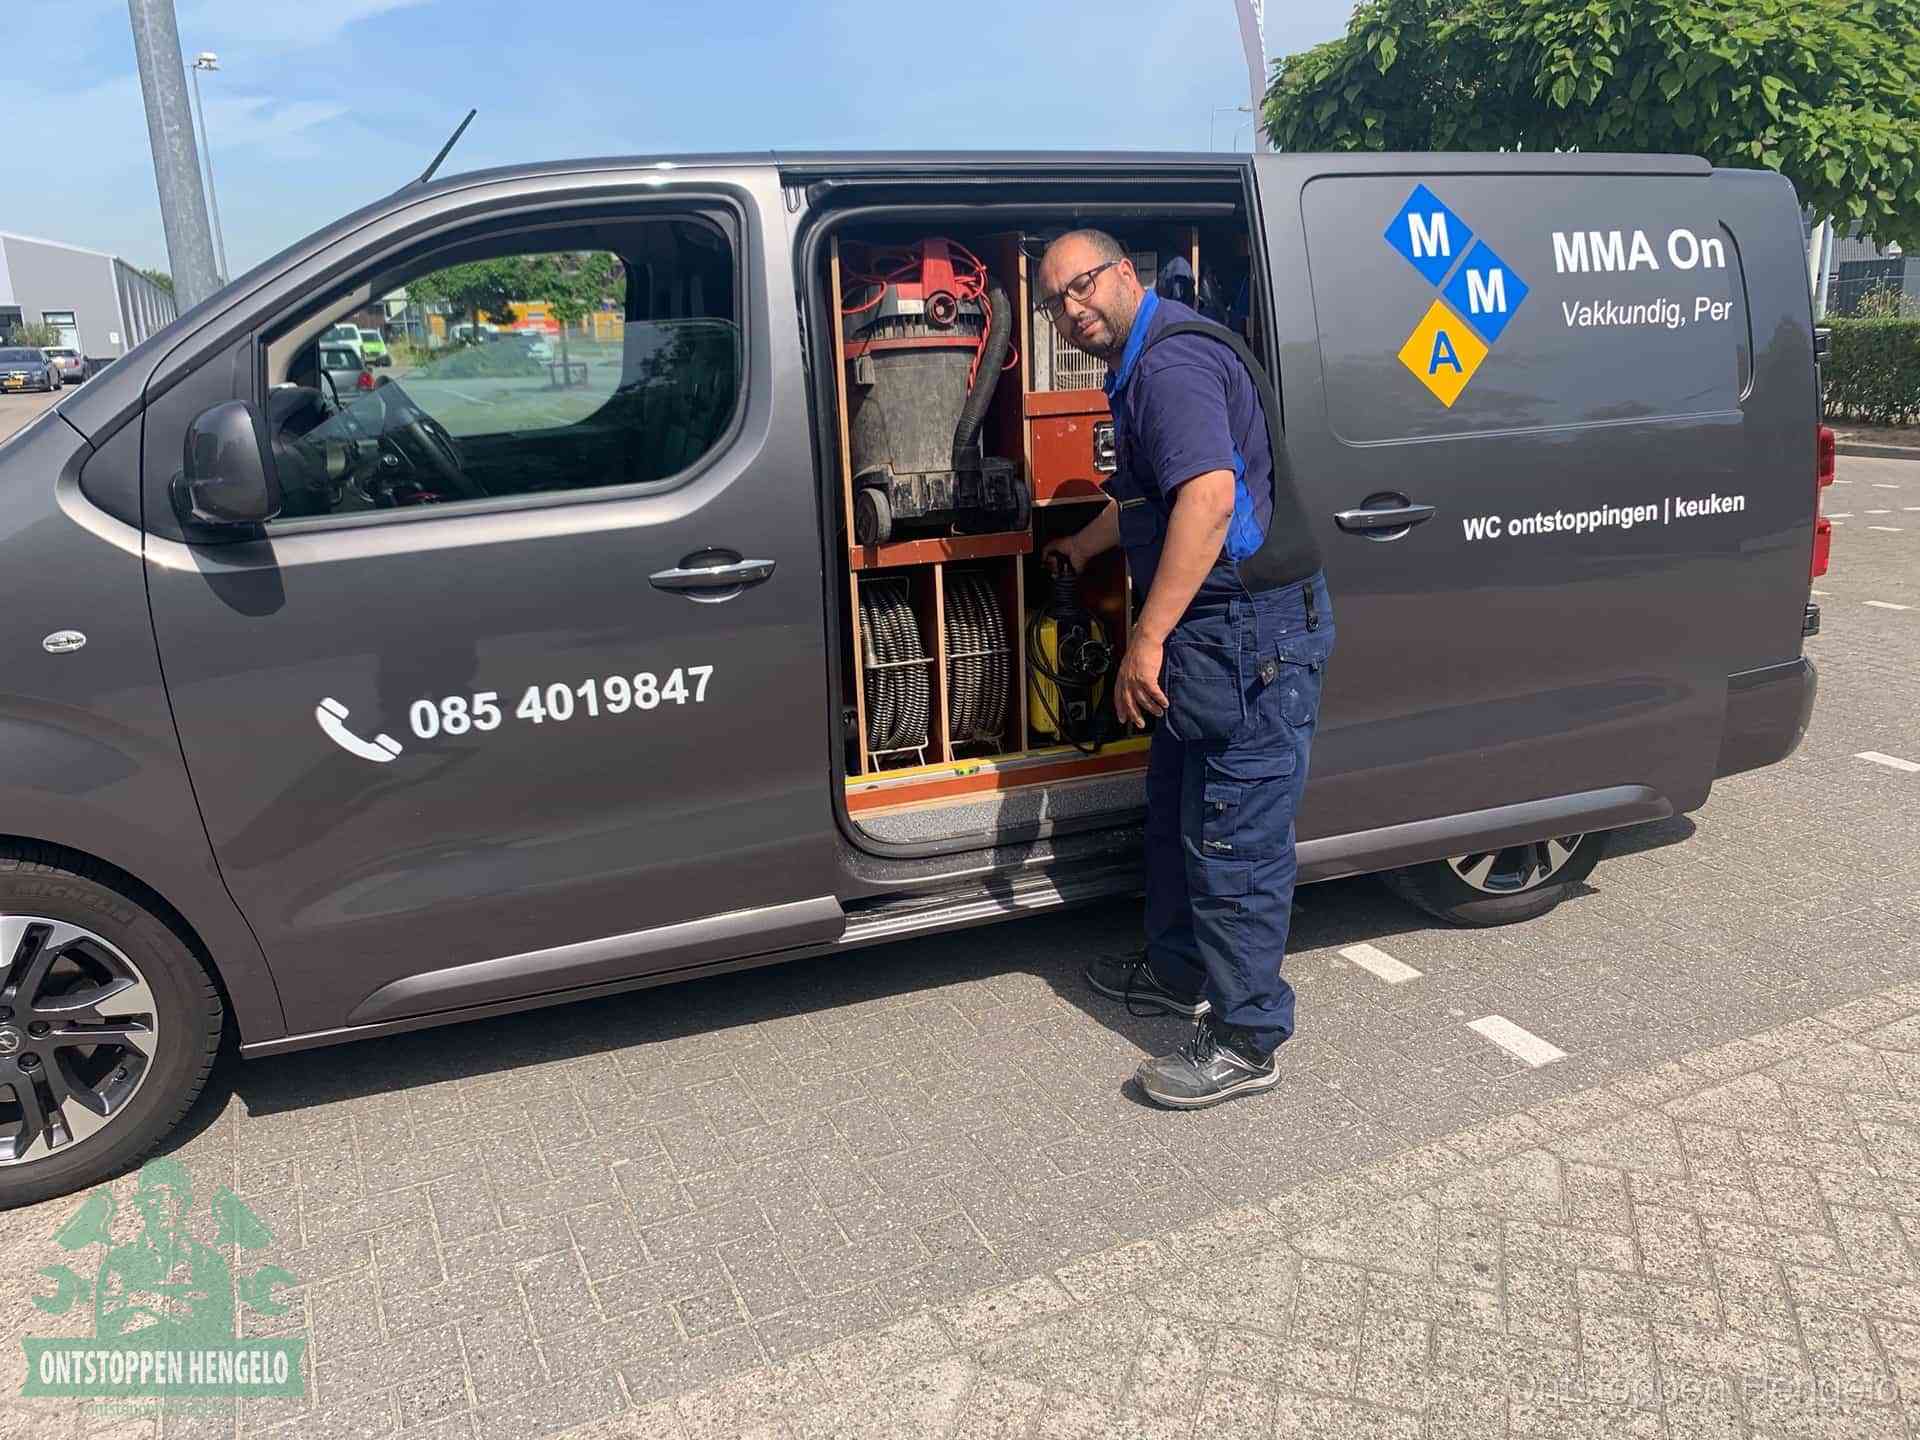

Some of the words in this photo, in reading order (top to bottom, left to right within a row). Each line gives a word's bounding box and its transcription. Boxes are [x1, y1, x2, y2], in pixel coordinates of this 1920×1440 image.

[1407, 212, 1451, 258] M
[1551, 230, 1660, 273] MMA
[1667, 227, 1727, 271] On
[1466, 268, 1507, 314] M
[1561, 298, 1687, 329] Vakkundig,
[1693, 296, 1734, 322] Per
[1428, 330, 1464, 375] A
[1462, 514, 1502, 541] WC
[1507, 503, 1659, 538] ontstoppingen
[1675, 492, 1746, 519] keuken
[409, 690, 503, 740] 085
[515, 664, 715, 725] 4019847
